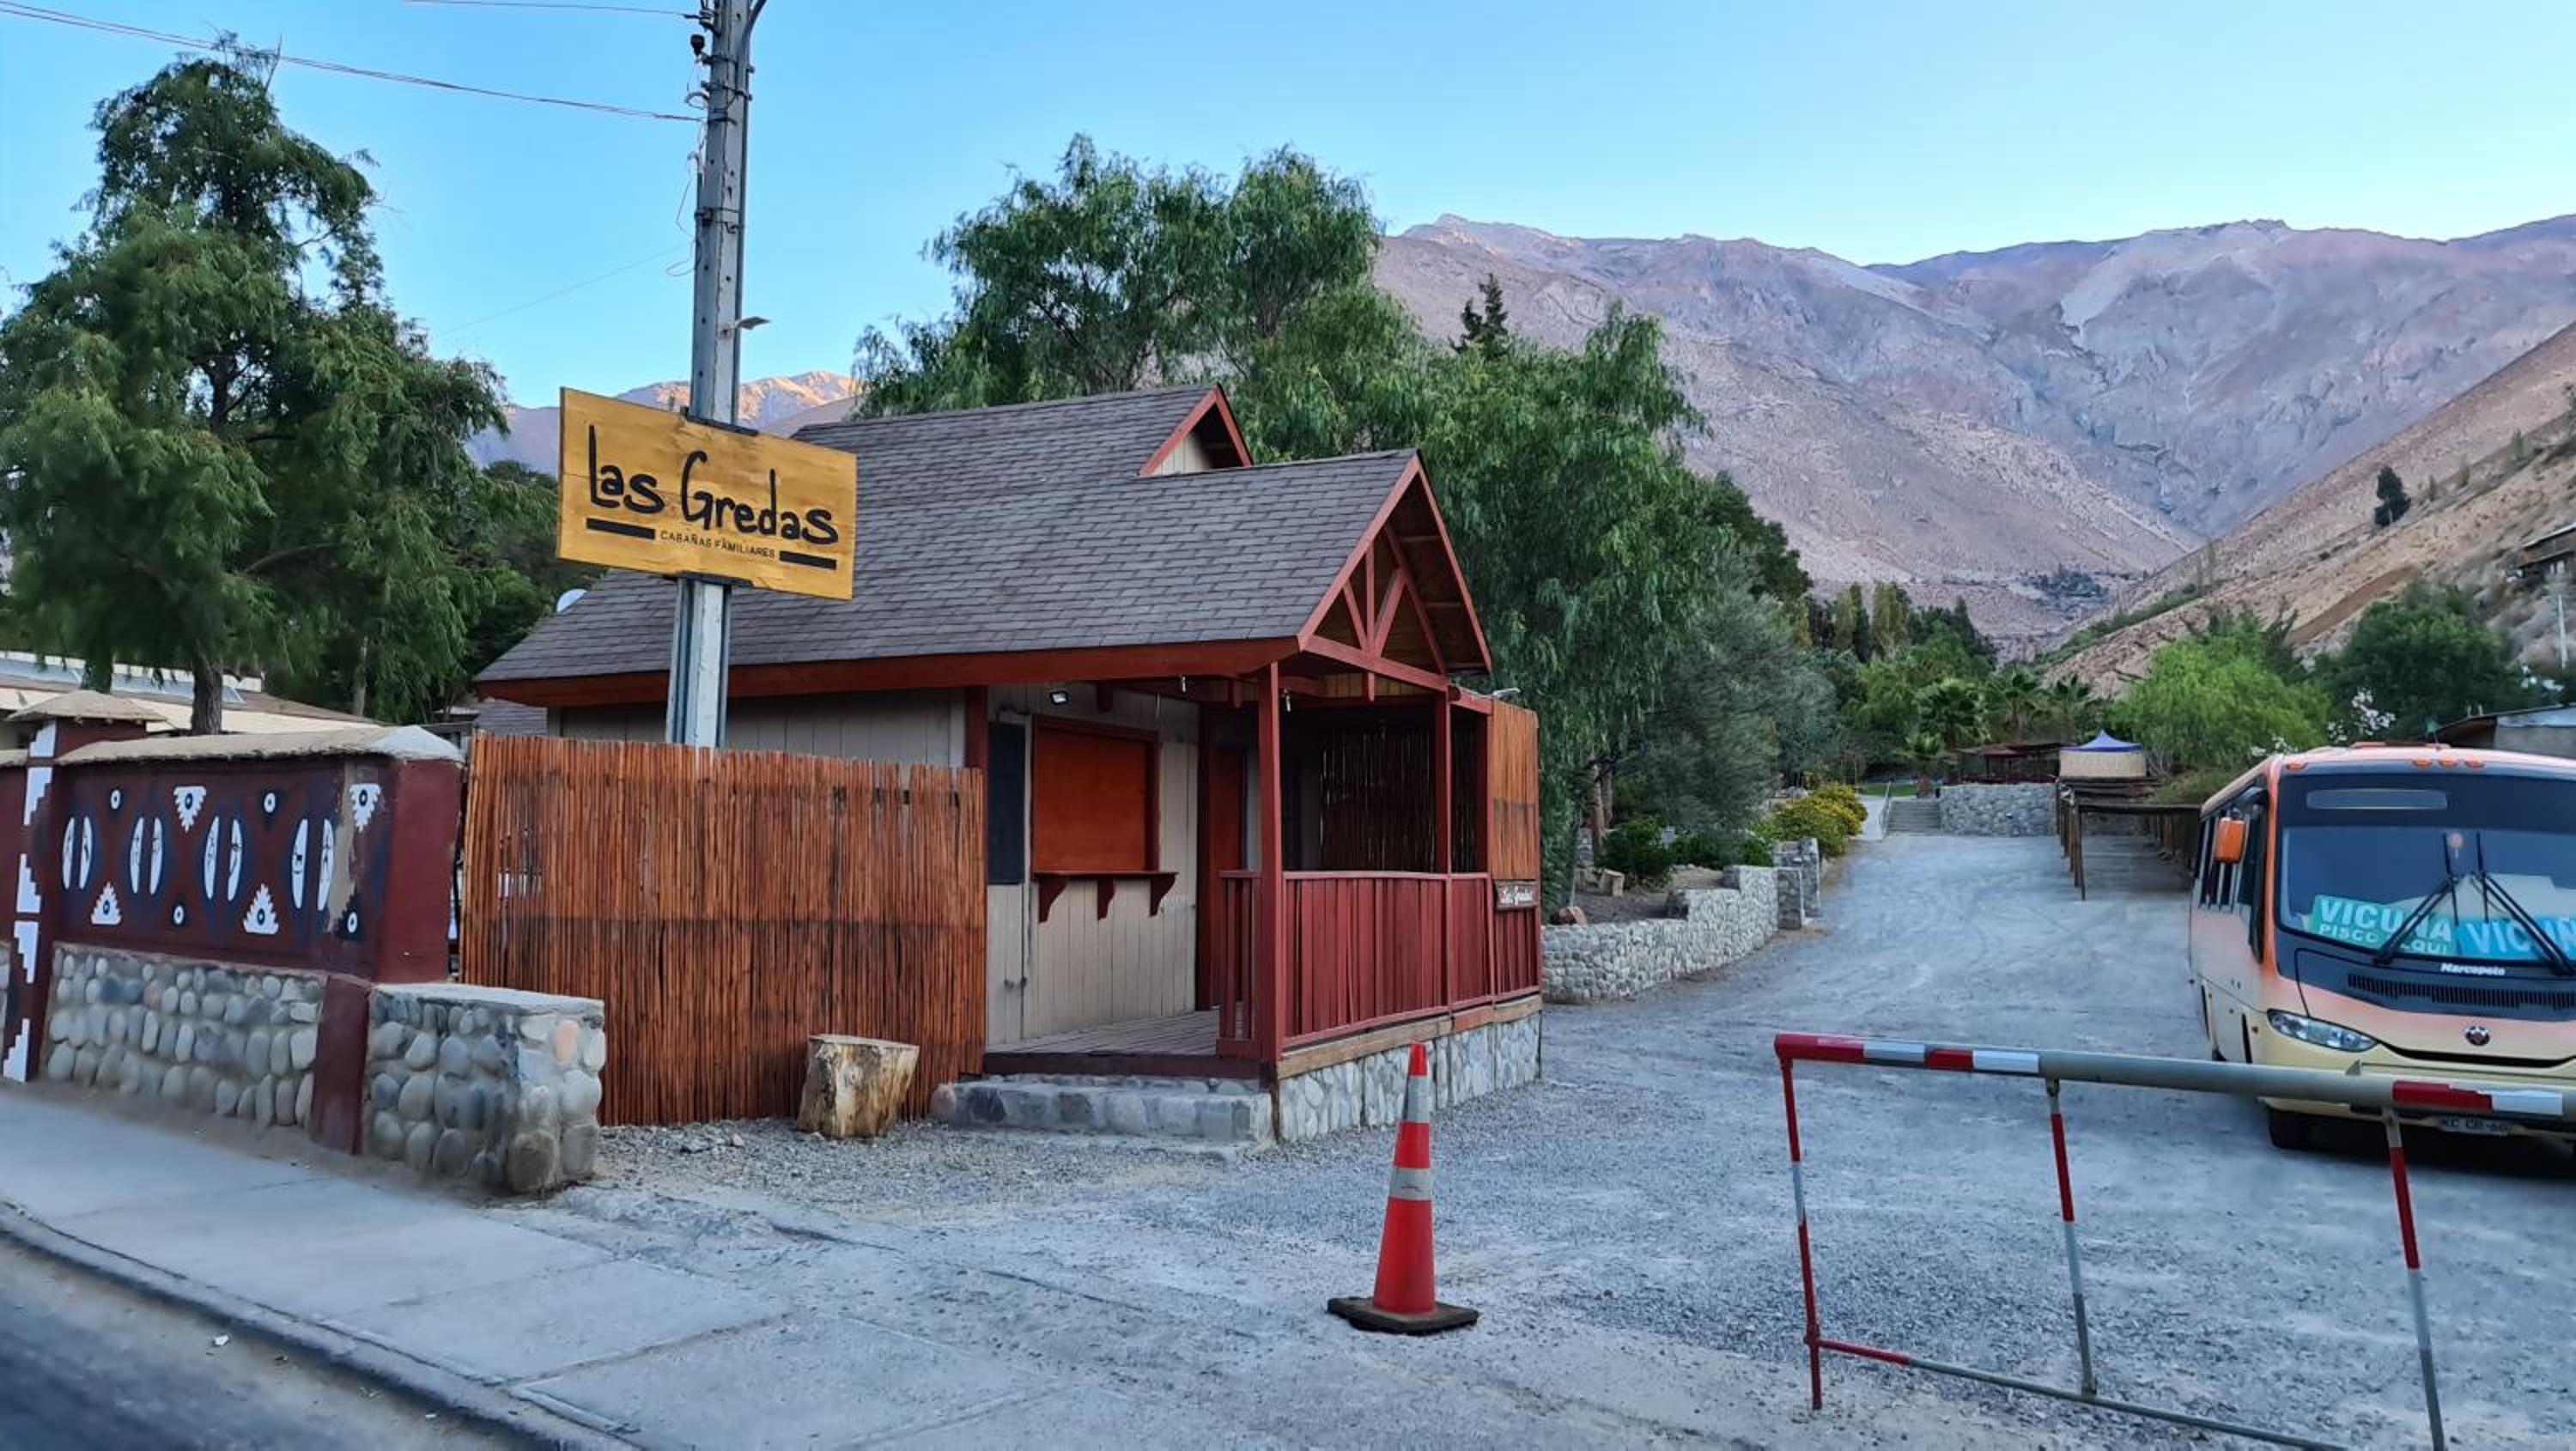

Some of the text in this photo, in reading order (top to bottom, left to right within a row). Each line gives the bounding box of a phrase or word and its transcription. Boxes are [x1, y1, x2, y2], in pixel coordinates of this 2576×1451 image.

[588, 425, 839, 545] Las Gredas
[659, 529, 776, 559] CABAÑAS FAMILIARES
[2319, 923, 2379, 943] PISCO
